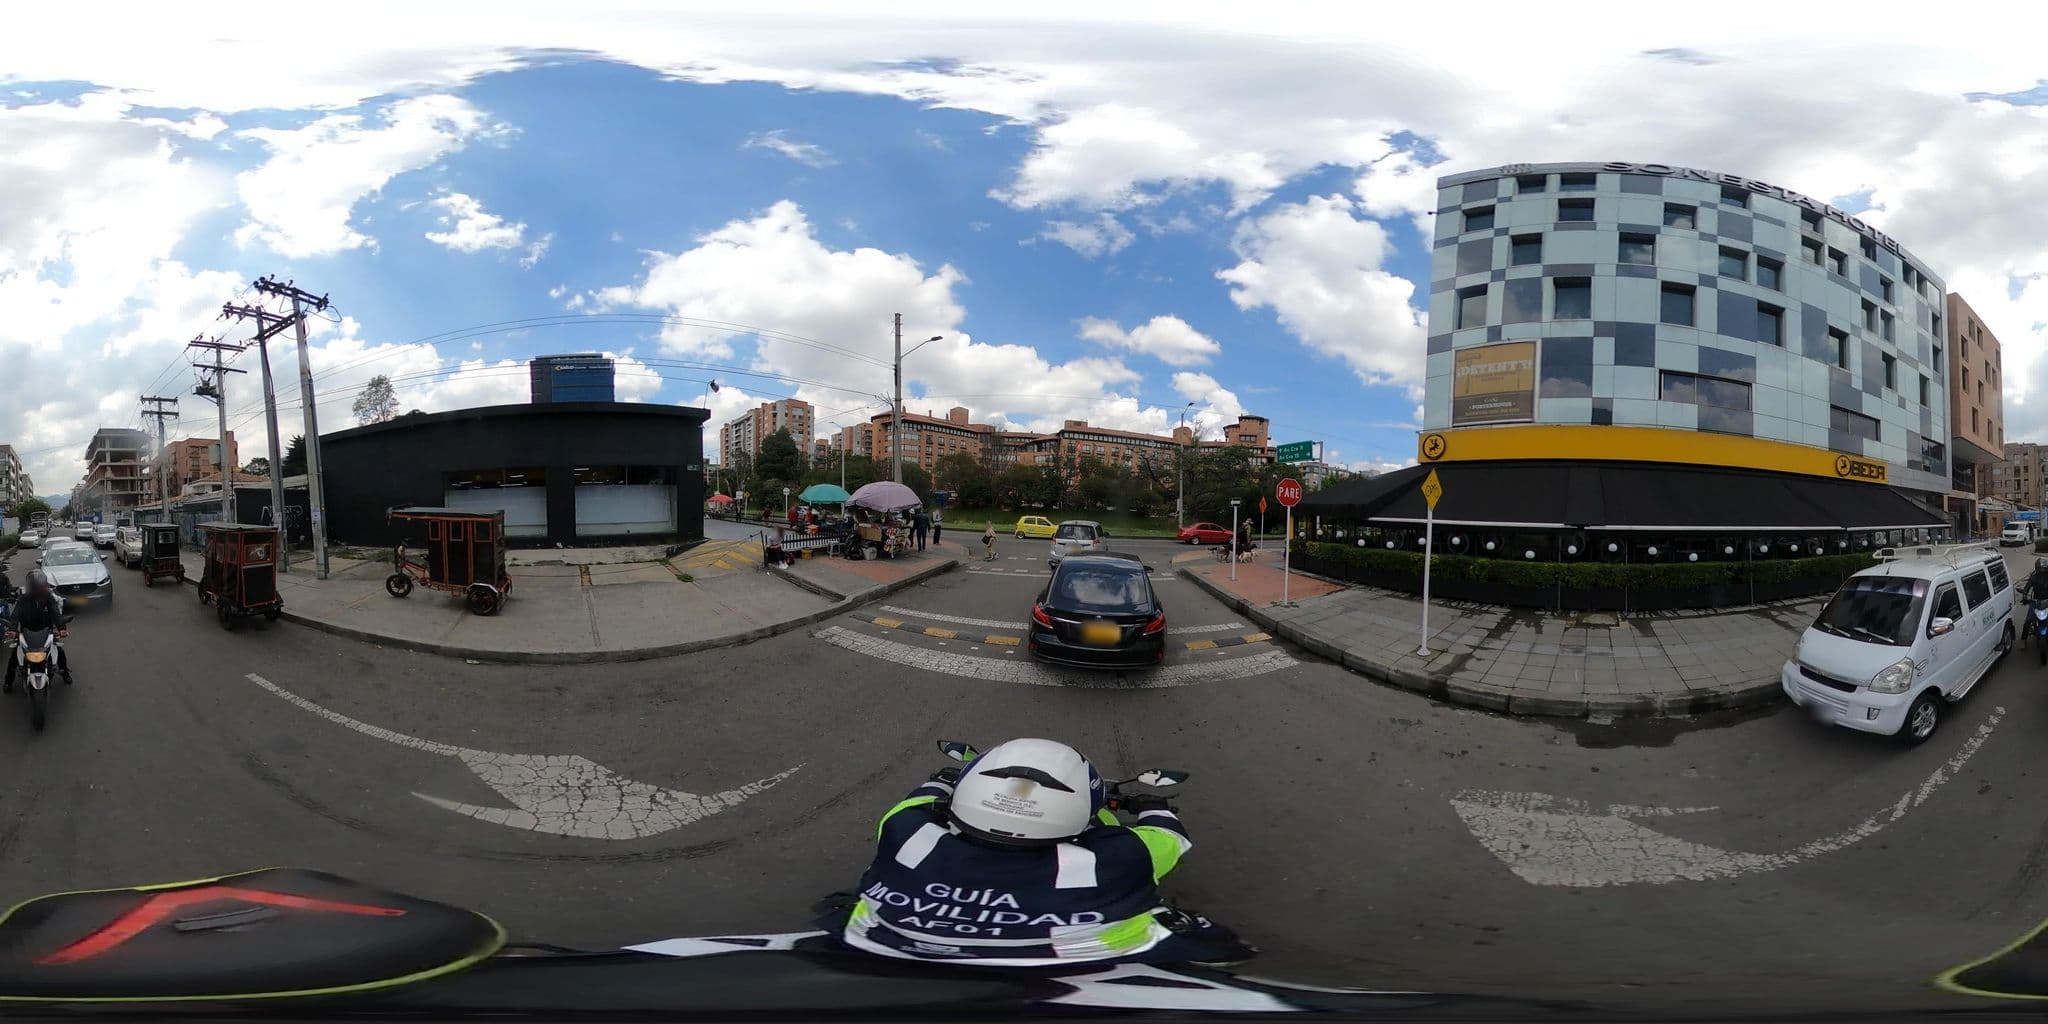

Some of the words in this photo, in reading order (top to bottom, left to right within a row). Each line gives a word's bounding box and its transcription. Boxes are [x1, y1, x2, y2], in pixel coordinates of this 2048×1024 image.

[1603, 162, 1815, 208] SONESTA
[1825, 203, 1907, 260] HOTEL
[1852, 461, 1885, 480] BEER
[1279, 486, 1300, 499] PARE
[865, 881, 1104, 925] MOVILIDAD
[925, 882, 1020, 909] GUÍA
